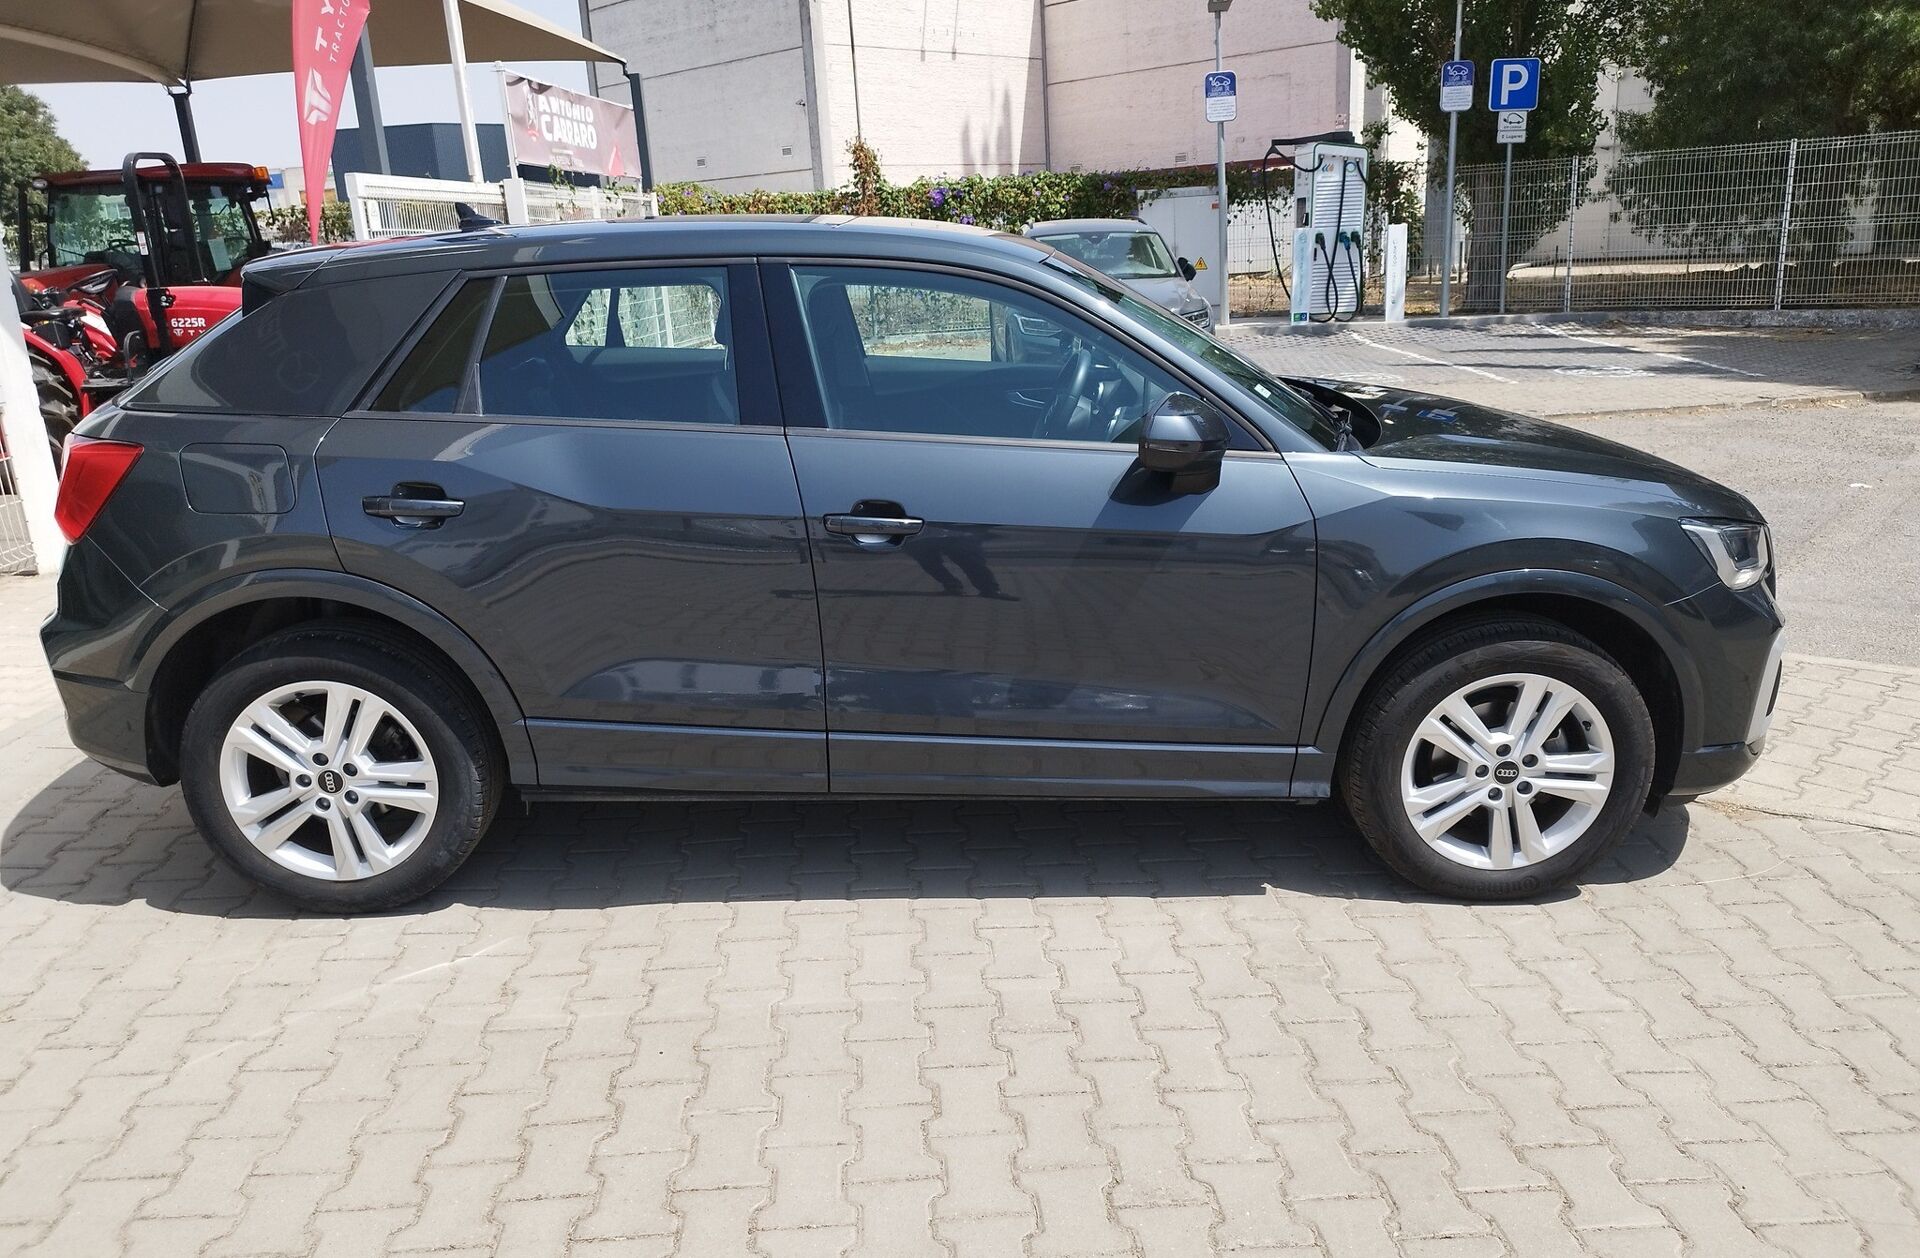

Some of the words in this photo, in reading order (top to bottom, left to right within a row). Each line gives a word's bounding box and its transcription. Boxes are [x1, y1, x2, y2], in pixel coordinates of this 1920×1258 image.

[1500, 64, 1529, 105] P
[538, 95, 594, 123] ANTONIO
[540, 114, 598, 150] CARRARO
[171, 317, 206, 328] 6225R
